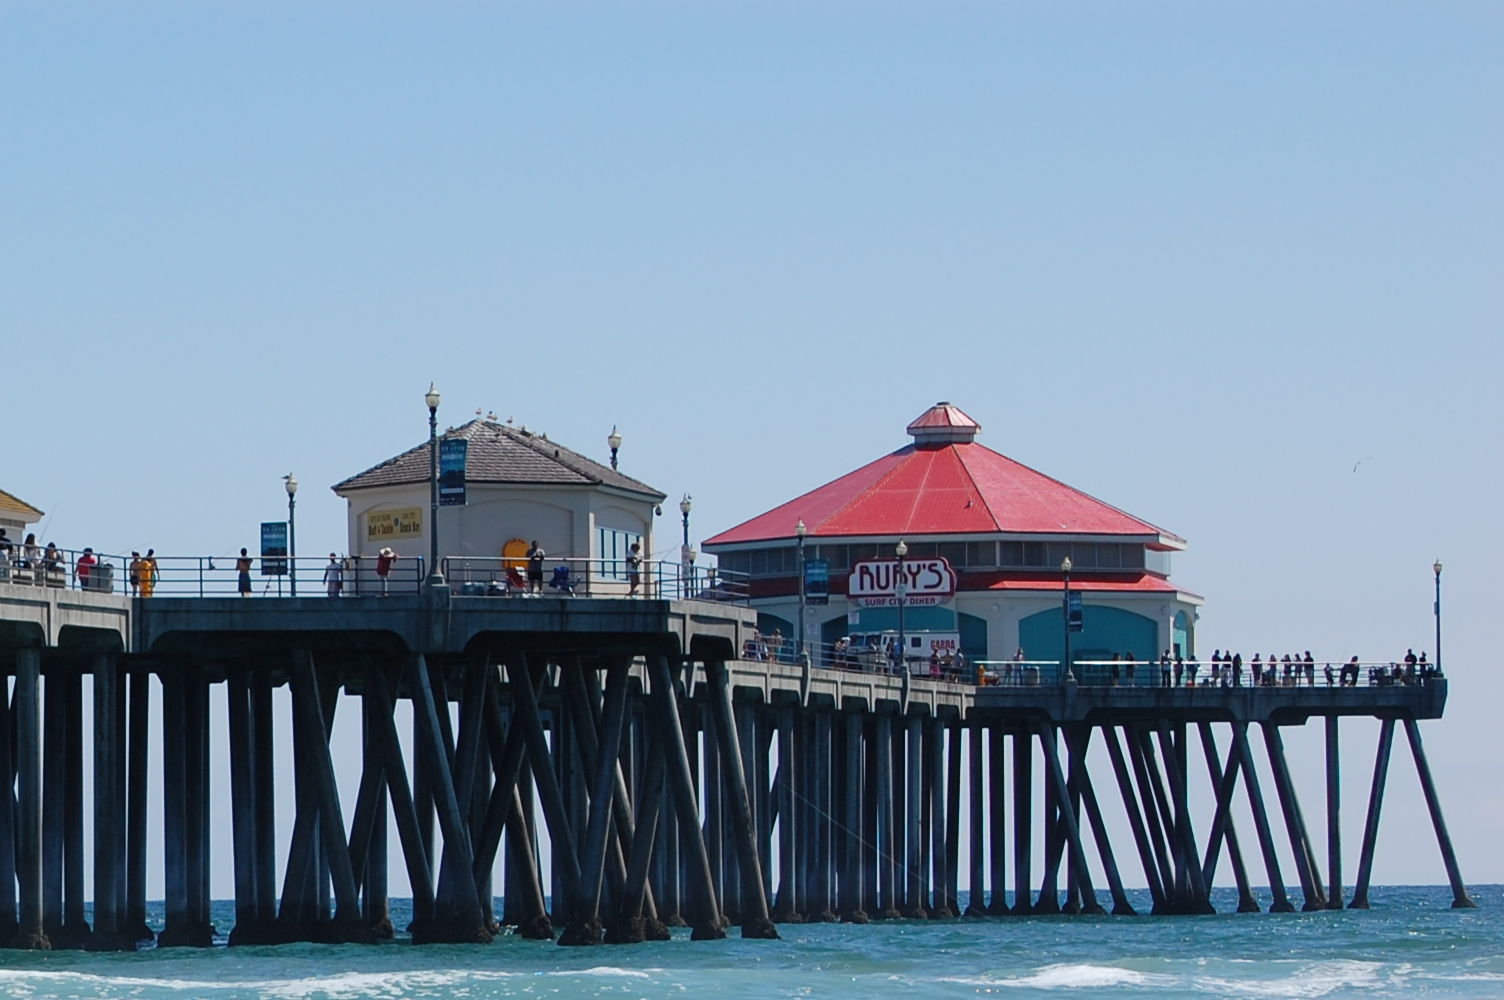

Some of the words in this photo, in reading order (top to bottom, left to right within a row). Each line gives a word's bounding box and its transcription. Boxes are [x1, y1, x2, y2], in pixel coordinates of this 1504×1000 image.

[859, 563, 943, 591] RUBY'S
[865, 598, 887, 606] SURF
[909, 597, 936, 605] DINER
